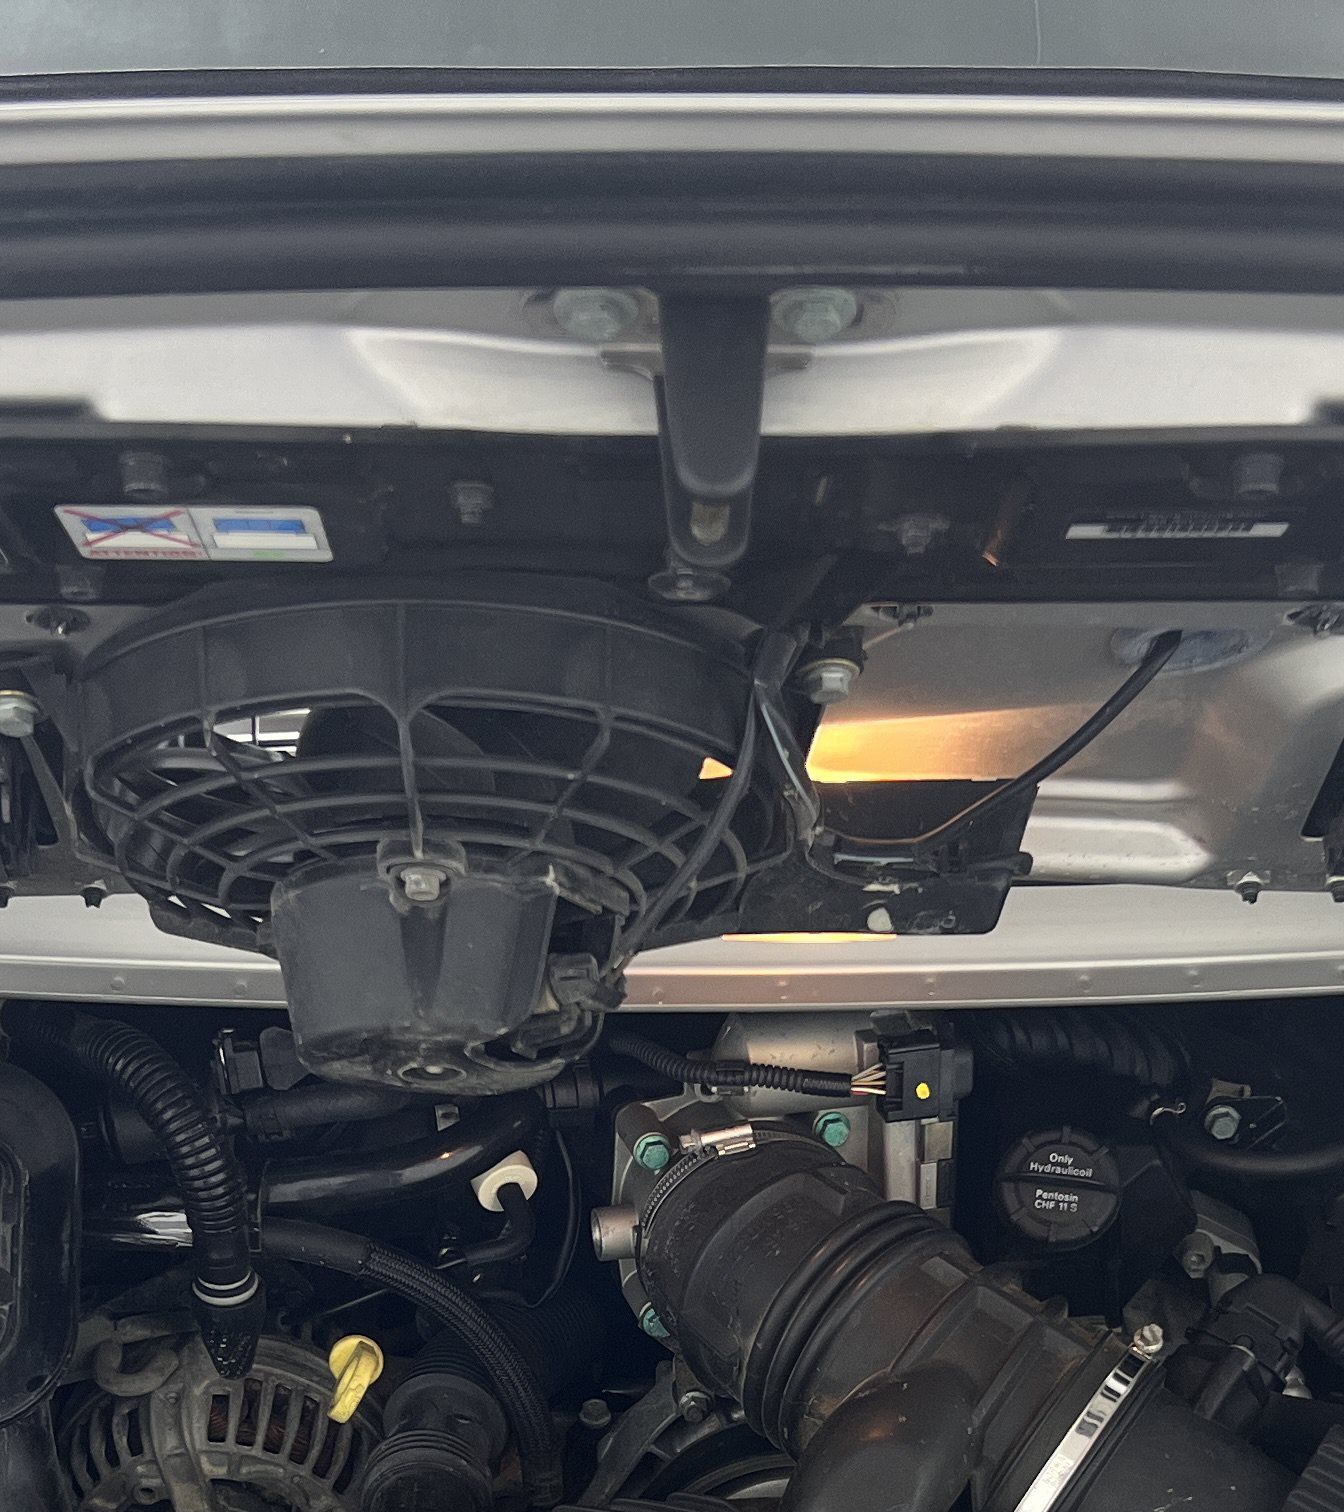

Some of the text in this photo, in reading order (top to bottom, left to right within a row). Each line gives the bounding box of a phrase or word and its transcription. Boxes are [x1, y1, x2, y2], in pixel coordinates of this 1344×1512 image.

[1049, 1152, 1074, 1165] Only
[1029, 1162, 1093, 1178] Hydraulicoil
[1034, 1188, 1079, 1203] Pentosin
[1033, 1199, 1078, 1213] CHF 11 S
